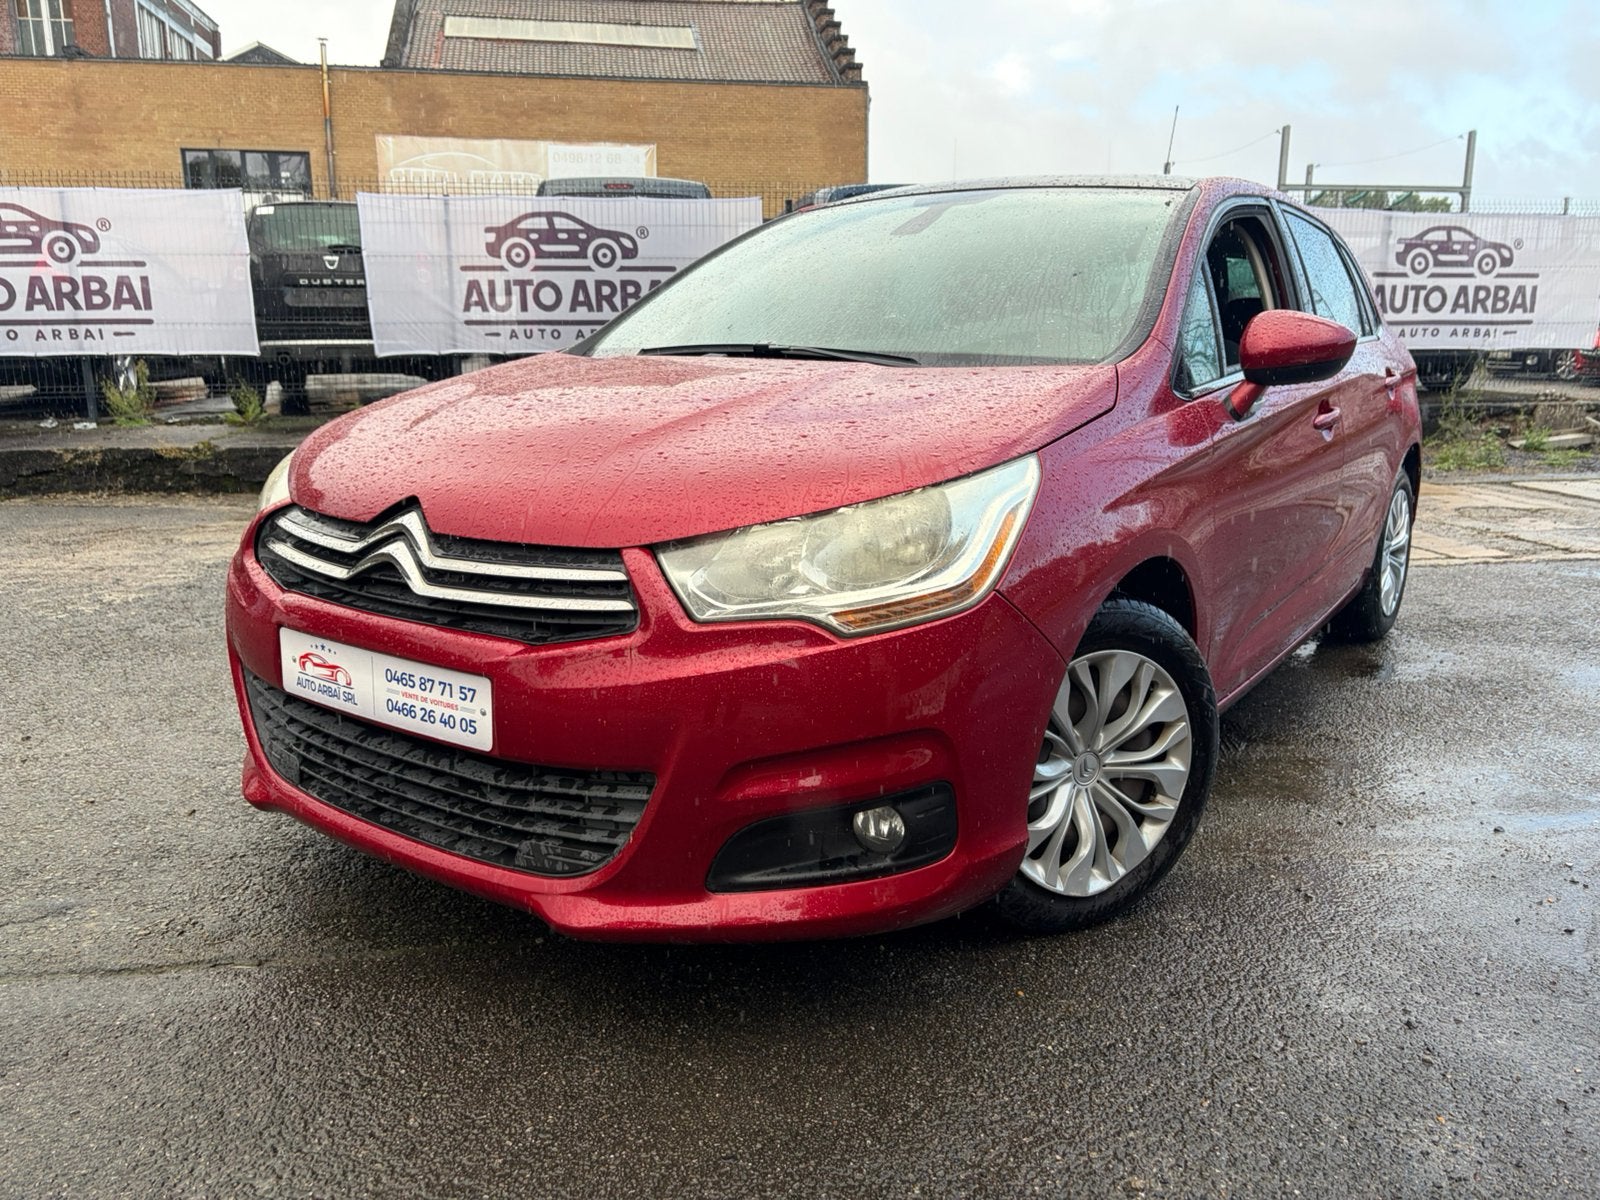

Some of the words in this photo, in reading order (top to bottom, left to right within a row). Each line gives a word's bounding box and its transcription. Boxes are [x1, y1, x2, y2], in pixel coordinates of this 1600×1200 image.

[25, 275, 153, 311] ARBAI
[299, 278, 366, 286] DUSTER
[463, 279, 563, 313] AUTO
[569, 279, 662, 313] ARB
[1450, 284, 1538, 314] ARBAI
[35, 328, 105, 341] ARBAI
[509, 328, 562, 340] AUTO
[1398, 327, 1440, 338] AUTO
[1449, 327, 1498, 339] ARBAI
[296, 676, 317, 692] AUTO
[342, 691, 358, 706] SRL
[385, 668, 416, 689] 0465
[419, 676, 435, 693] 87
[438, 681, 453, 698] 71
[459, 685, 477, 703] 57
[401, 691, 419, 702] VENTE
[430, 699, 459, 711] VOITURES
[386, 698, 417, 719] 0466
[420, 707, 436, 724] 26
[439, 713, 456, 729] 40
[460, 718, 477, 735] 05
